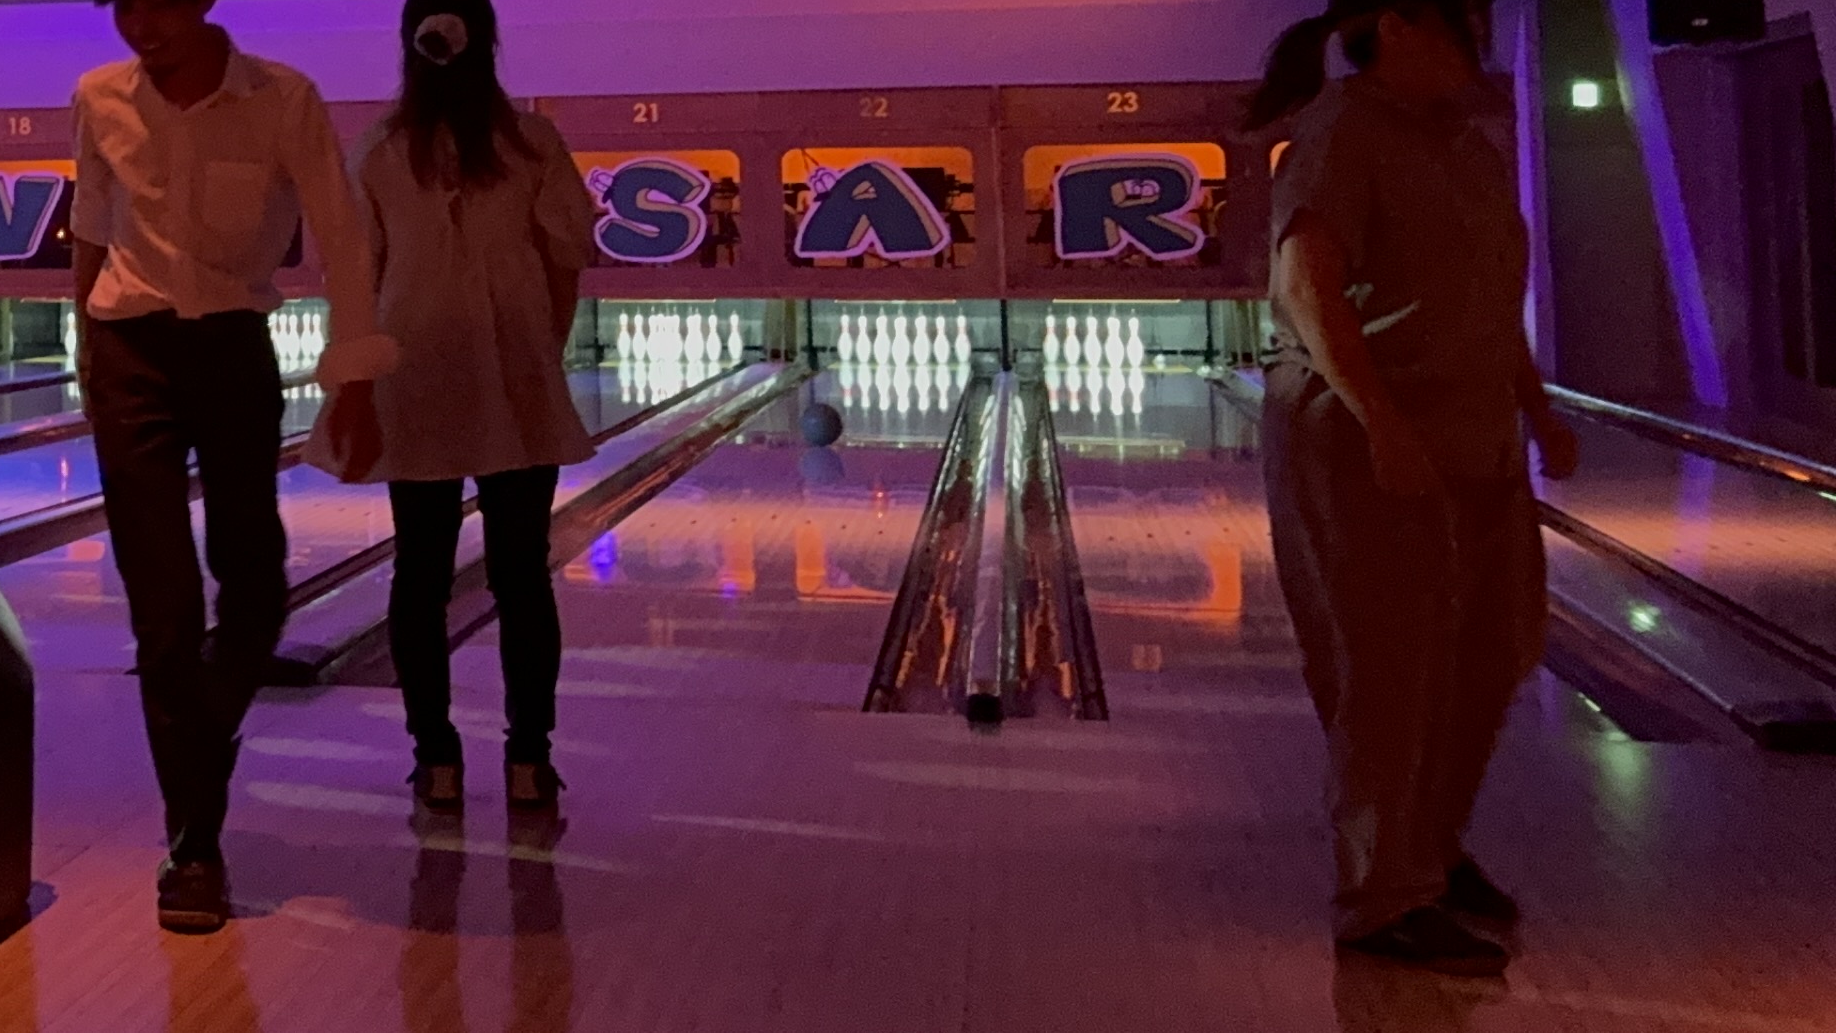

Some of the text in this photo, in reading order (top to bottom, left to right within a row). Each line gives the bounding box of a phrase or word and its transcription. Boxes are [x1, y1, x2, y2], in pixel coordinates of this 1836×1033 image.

[9, 117, 32, 135] 18
[633, 103, 658, 123] 21
[860, 98, 888, 118] 22
[1108, 93, 1140, 113] 23
[595, 157, 711, 262] S
[795, 160, 951, 258] A
[1054, 152, 1205, 260] R
